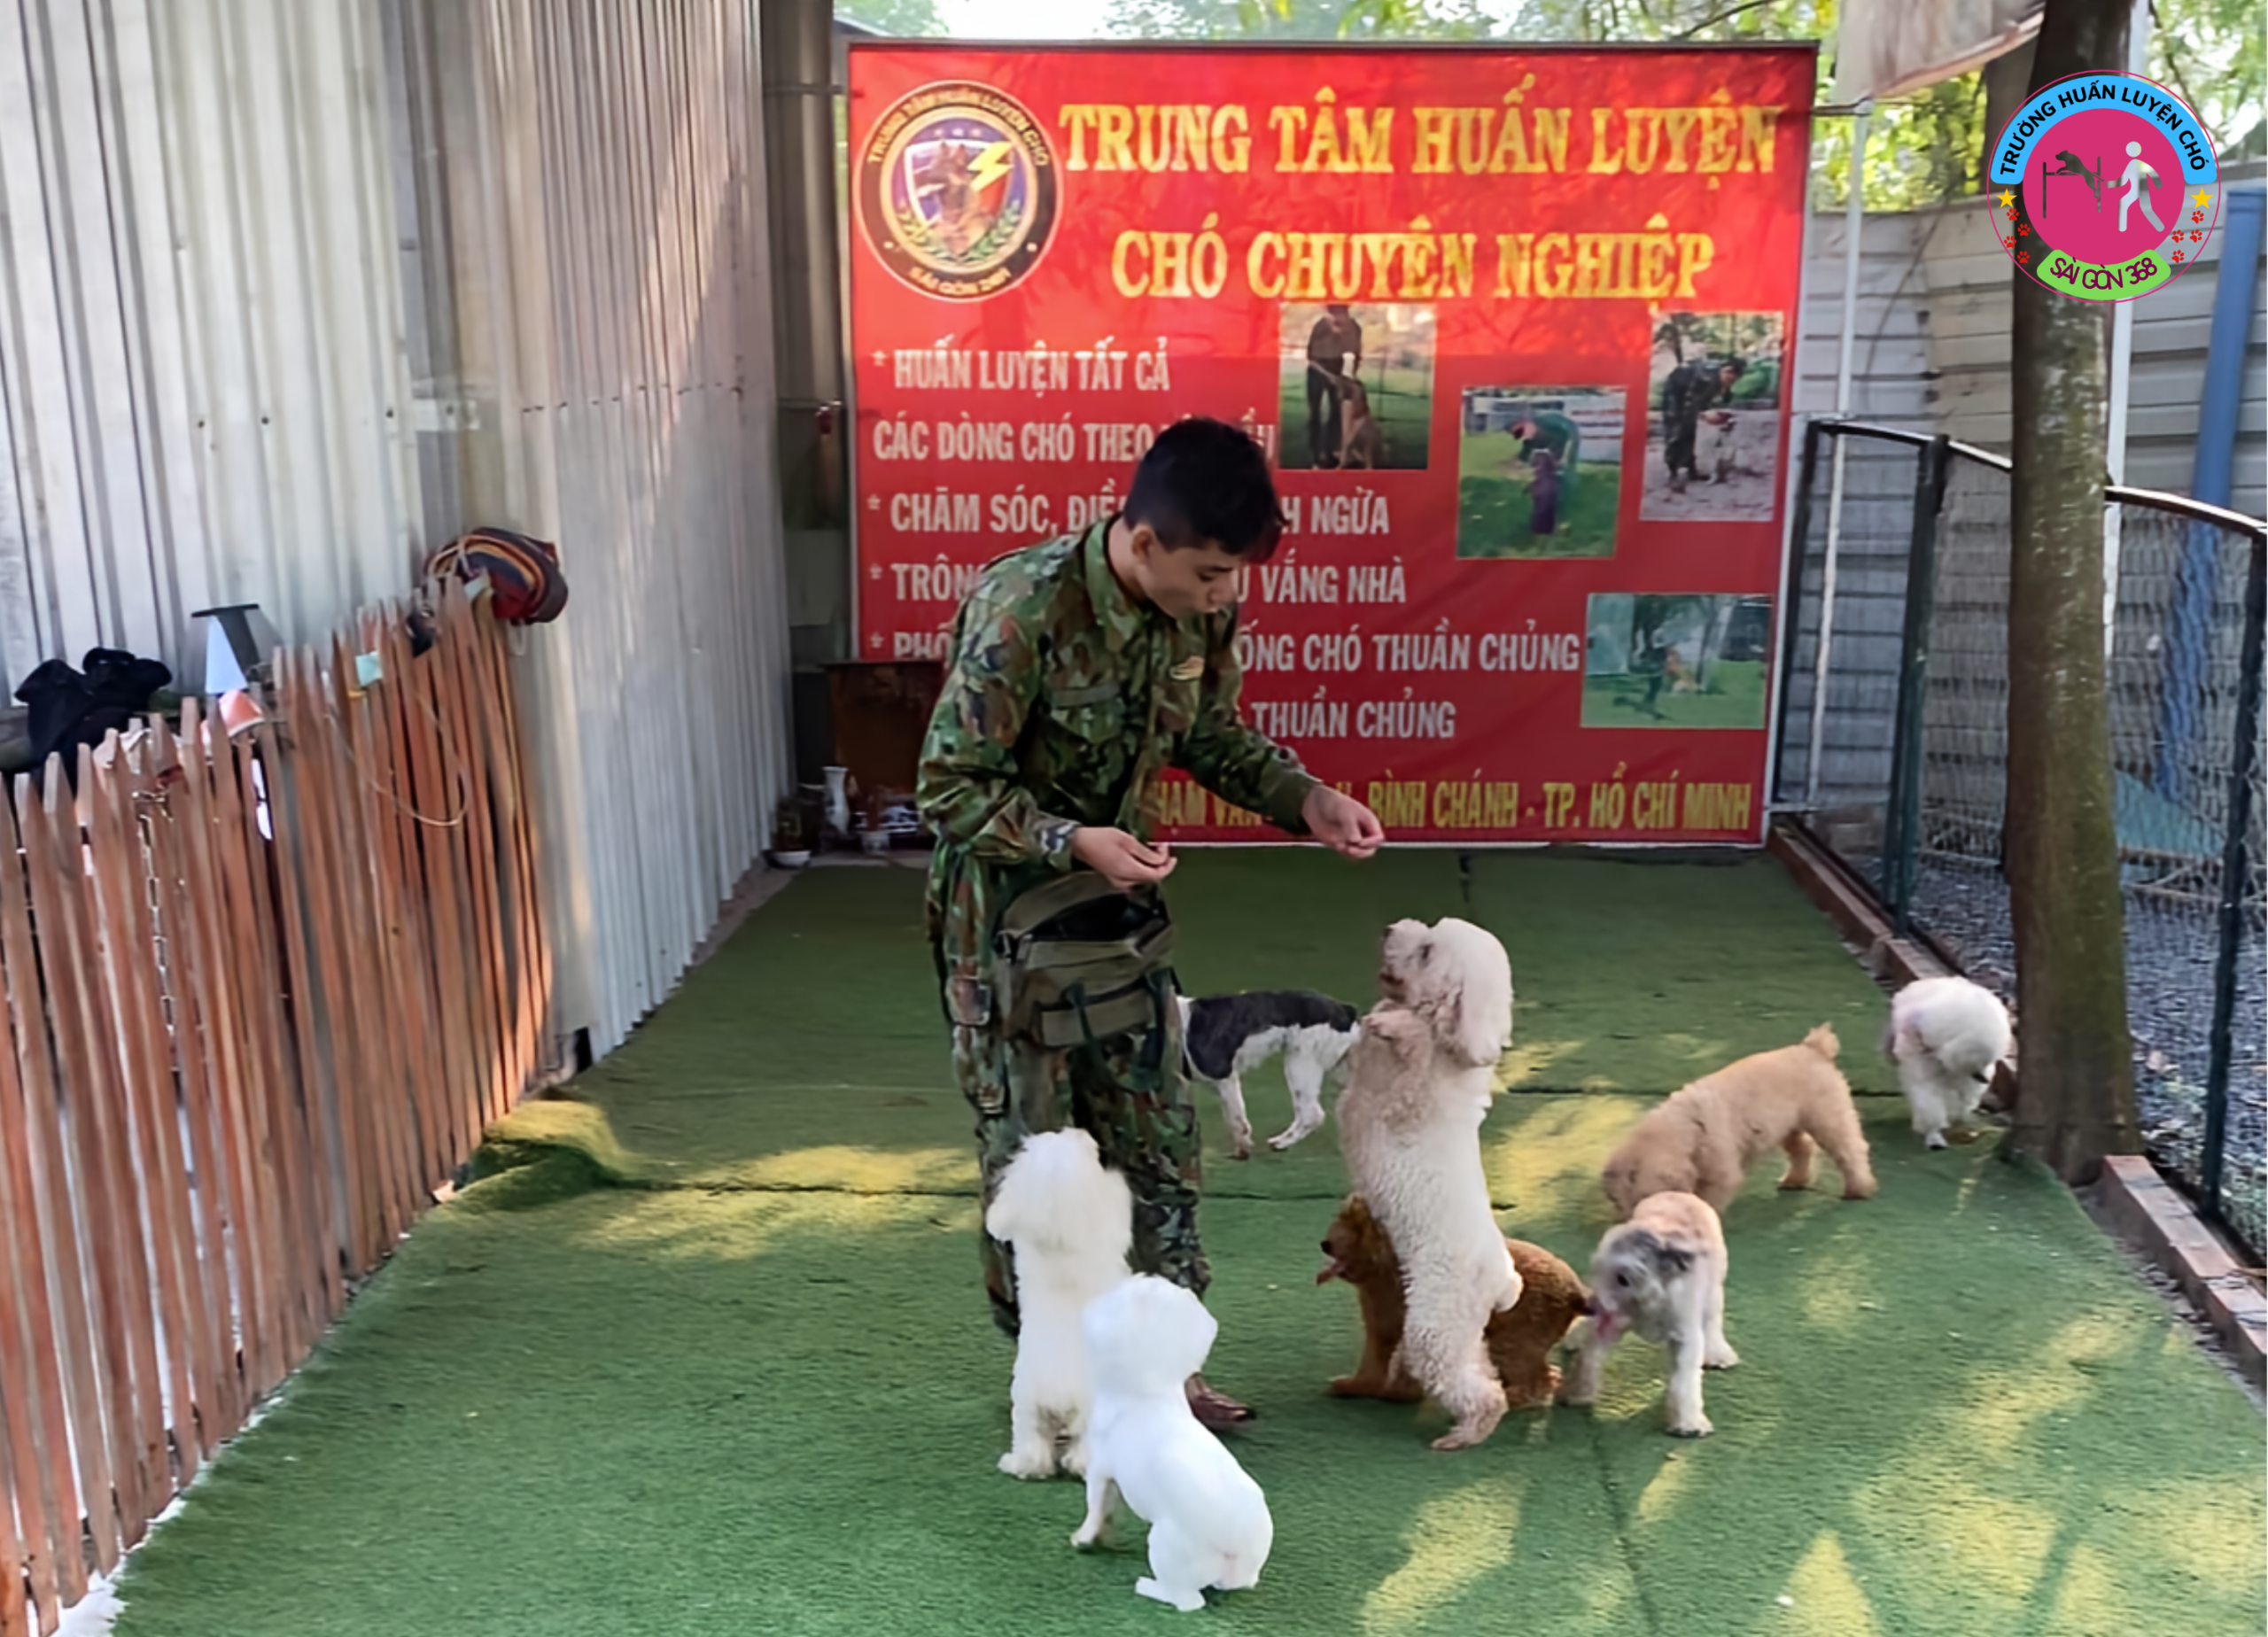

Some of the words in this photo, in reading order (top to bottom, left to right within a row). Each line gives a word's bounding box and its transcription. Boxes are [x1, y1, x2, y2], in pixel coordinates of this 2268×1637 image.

[1058, 104, 1251, 173] TRUNG
[1269, 86, 1394, 174] TÂM
[1412, 73, 1573, 175] HUẤN
[1587, 86, 1785, 190] LUYỆN
[1111, 213, 1227, 299] CHÓ
[1246, 214, 1477, 299] CHUYÊN
[1494, 213, 1714, 318] NGHIỆP
[894, 334, 971, 389] HUẤN
[979, 340, 1068, 398] LUYỆN
[1074, 336, 1128, 391] TẤT
[1134, 336, 1169, 391] CẢ
[874, 411, 929, 461] CÁC
[936, 411, 1014, 462] DÒNG
[1020, 412, 1075, 462] CHÓ
[1082, 423, 1154, 462] THEO
[890, 487, 980, 532] CHĂM
[989, 485, 1058, 536] SÓC,
[1310, 486, 1390, 534] NGỪA
[890, 554, 985, 601] TRÔN
[1261, 548, 1339, 604] VẮNG
[1347, 556, 1407, 604] NHÀ
[1302, 624, 1362, 671] CHÓ
[1372, 617, 1471, 672] THUẦN
[1479, 619, 1580, 672] CHỦNG
[1250, 686, 1348, 739] THUẦN
[1355, 687, 1456, 739] CHỦNG
[1433, 768, 1518, 828] CHÁNH
[1542, 782, 1580, 828] TP.
[1632, 769, 1679, 829] CHÍ
[1683, 782, 1751, 830] MINH
